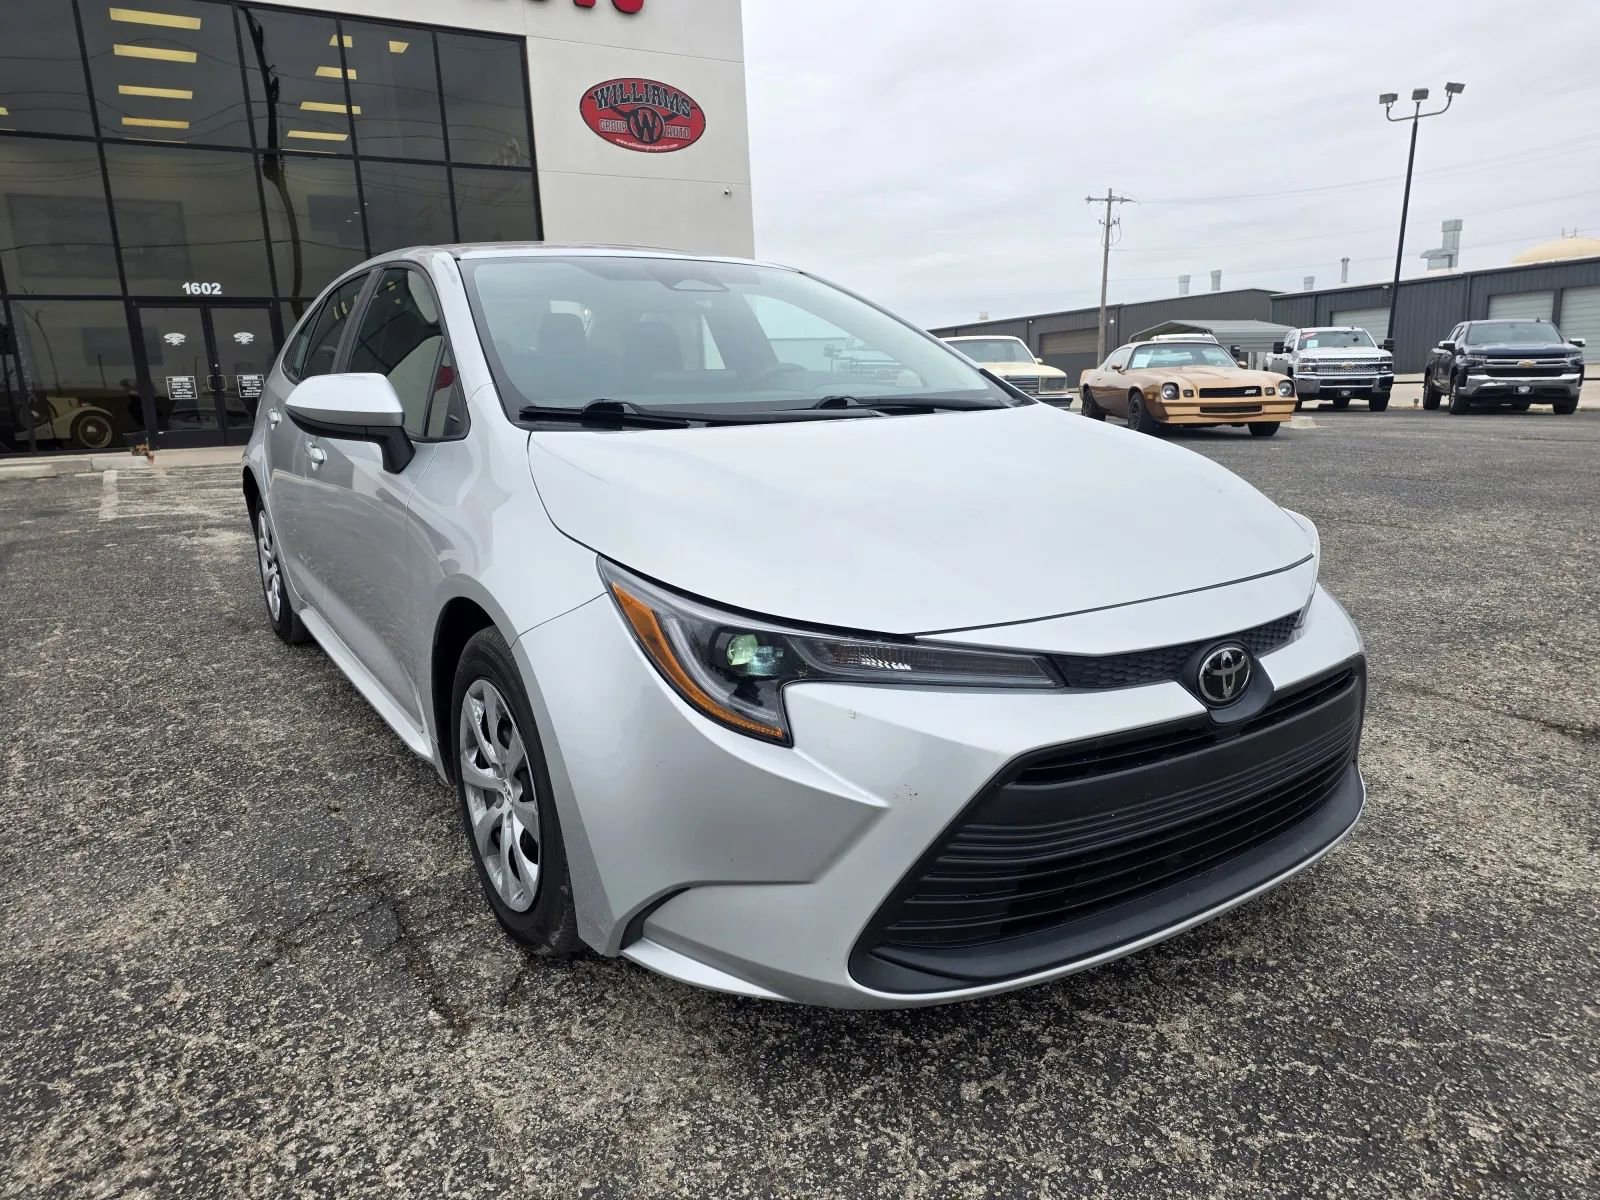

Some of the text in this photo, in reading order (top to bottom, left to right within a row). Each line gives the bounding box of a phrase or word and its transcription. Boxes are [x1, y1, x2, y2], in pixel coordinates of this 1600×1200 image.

[594, 82, 691, 118] WILLIAMS
[600, 119, 690, 139] GROUP AUTO
[633, 109, 660, 141] W
[182, 282, 222, 294] 1602
